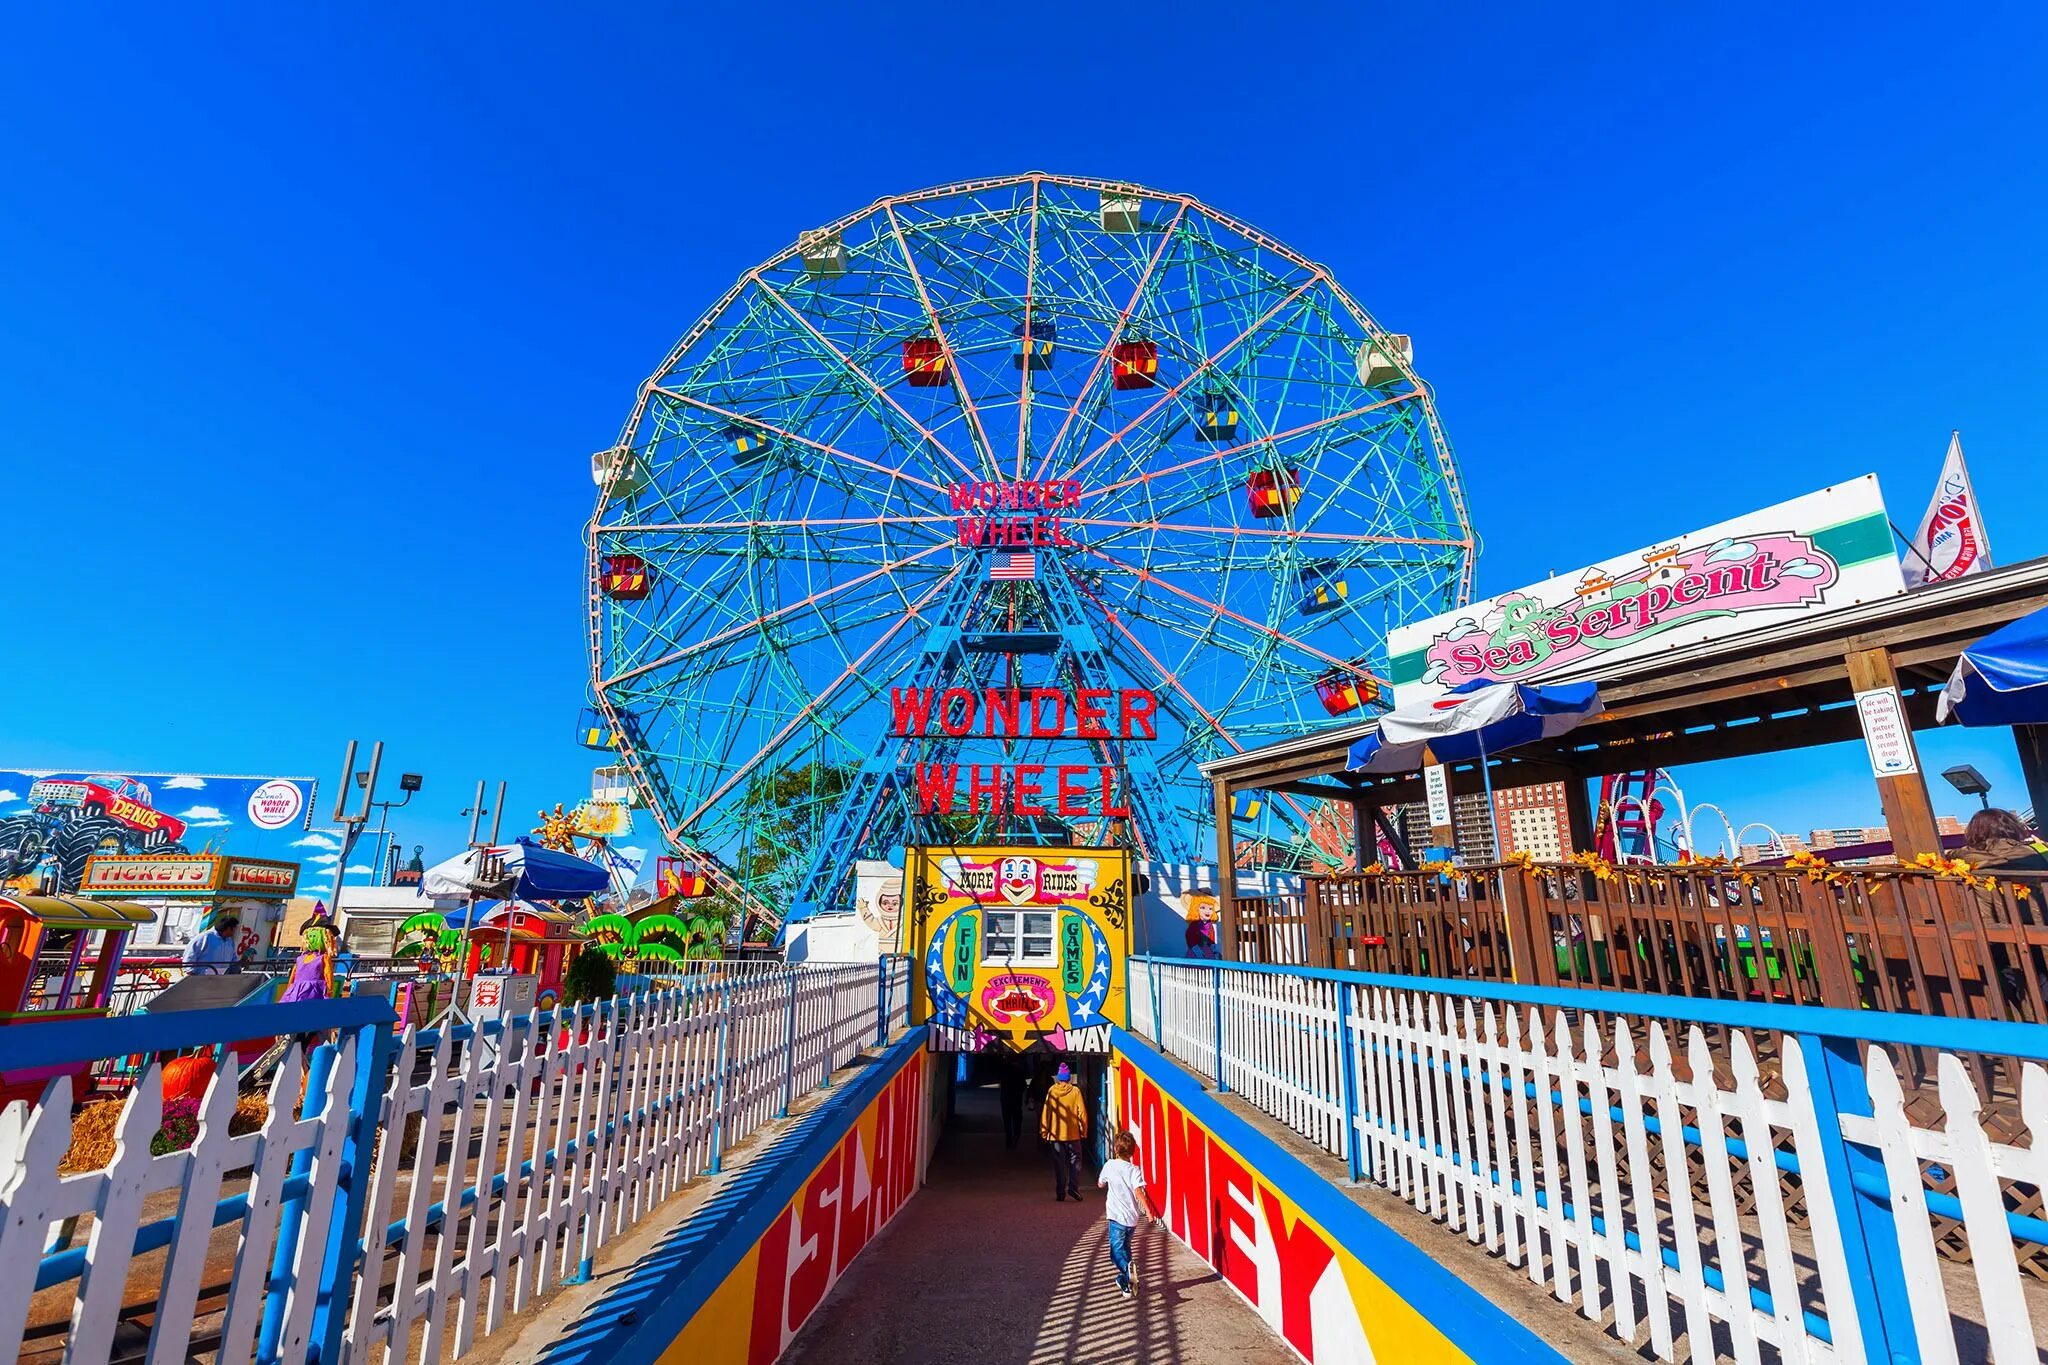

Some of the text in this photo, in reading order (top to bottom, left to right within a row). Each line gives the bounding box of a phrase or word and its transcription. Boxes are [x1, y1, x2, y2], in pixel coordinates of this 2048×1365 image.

[949, 480, 1082, 510] WONDER
[956, 516, 1073, 547] WHEEL
[1450, 552, 1778, 676] Sea Serpent
[1866, 697, 1889, 707] We will
[1873, 706, 1895, 715] taking
[891, 687, 1158, 739] WONDER
[1874, 716, 1888, 724] your
[1872, 724, 1895, 732] picture
[1877, 741, 1899, 749] second
[915, 763, 1131, 817] WHEEL
[260, 799, 290, 807] WONDER
[100, 864, 205, 881] TICKETS
[232, 865, 291, 885] TICKETS
[960, 871, 1077, 891] MORE RIDES
[958, 928, 971, 981] FUN
[1067, 922, 1079, 985] GAMES
[481, 984, 496, 992] FIRE
[993, 976, 1046, 988] EXCITEMENT
[1000, 998, 1039, 1011] THRILLS
[928, 1022, 1114, 1053] THIS WAY
[748, 1051, 921, 1365] ISLAND
[1120, 1057, 1335, 1365] CONEY
